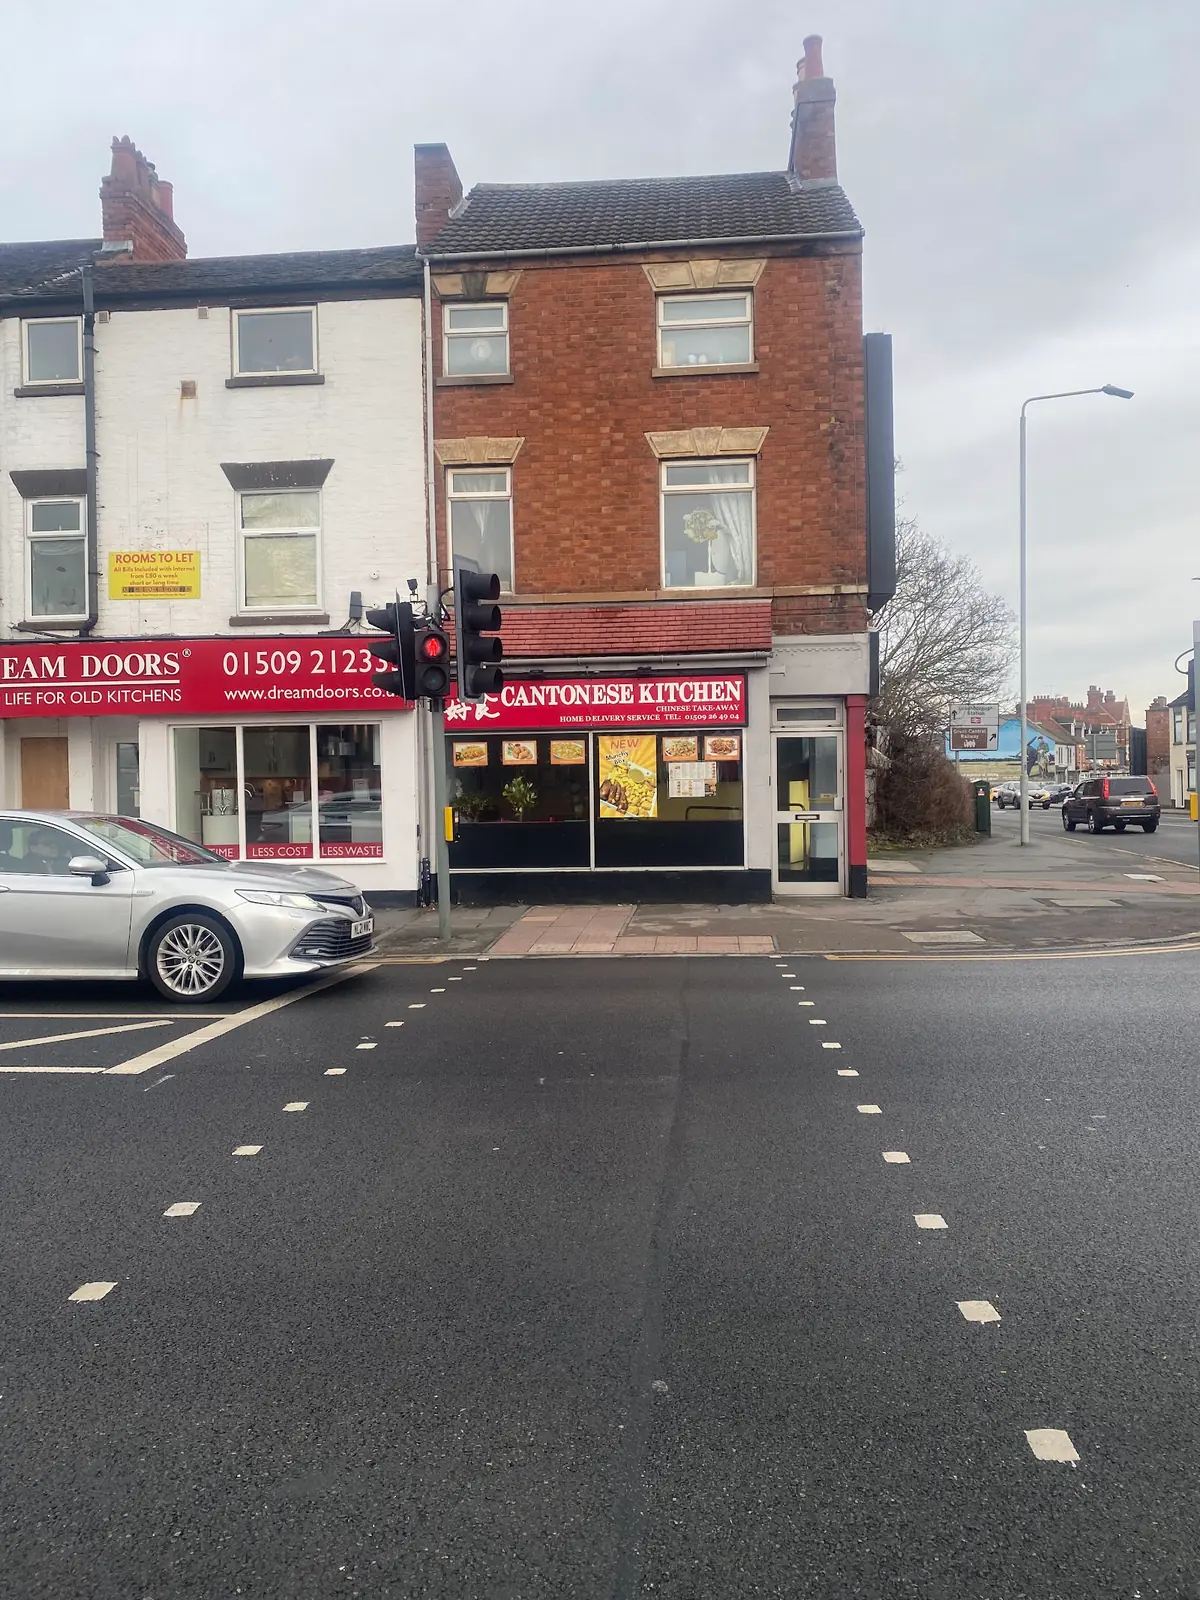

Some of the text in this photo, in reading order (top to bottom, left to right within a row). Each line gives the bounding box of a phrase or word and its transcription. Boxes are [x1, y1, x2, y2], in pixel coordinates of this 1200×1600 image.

[115, 553, 194, 564] ROOMS TO LET
[222, 650, 302, 676] 01509
[5, 688, 182, 705] LIFE FOR OLD KITCHENS
[500, 680, 742, 707] CANTONESE KITCHEN
[692, 704, 740, 712] TAKE-AWAY
[559, 715, 584, 723] HOME
[626, 713, 661, 721] SERVICE
[664, 713, 682, 721] TEL:
[610, 738, 640, 750] NEW
[252, 846, 308, 857] LESS COST
[321, 845, 382, 856] LESS WASTE
